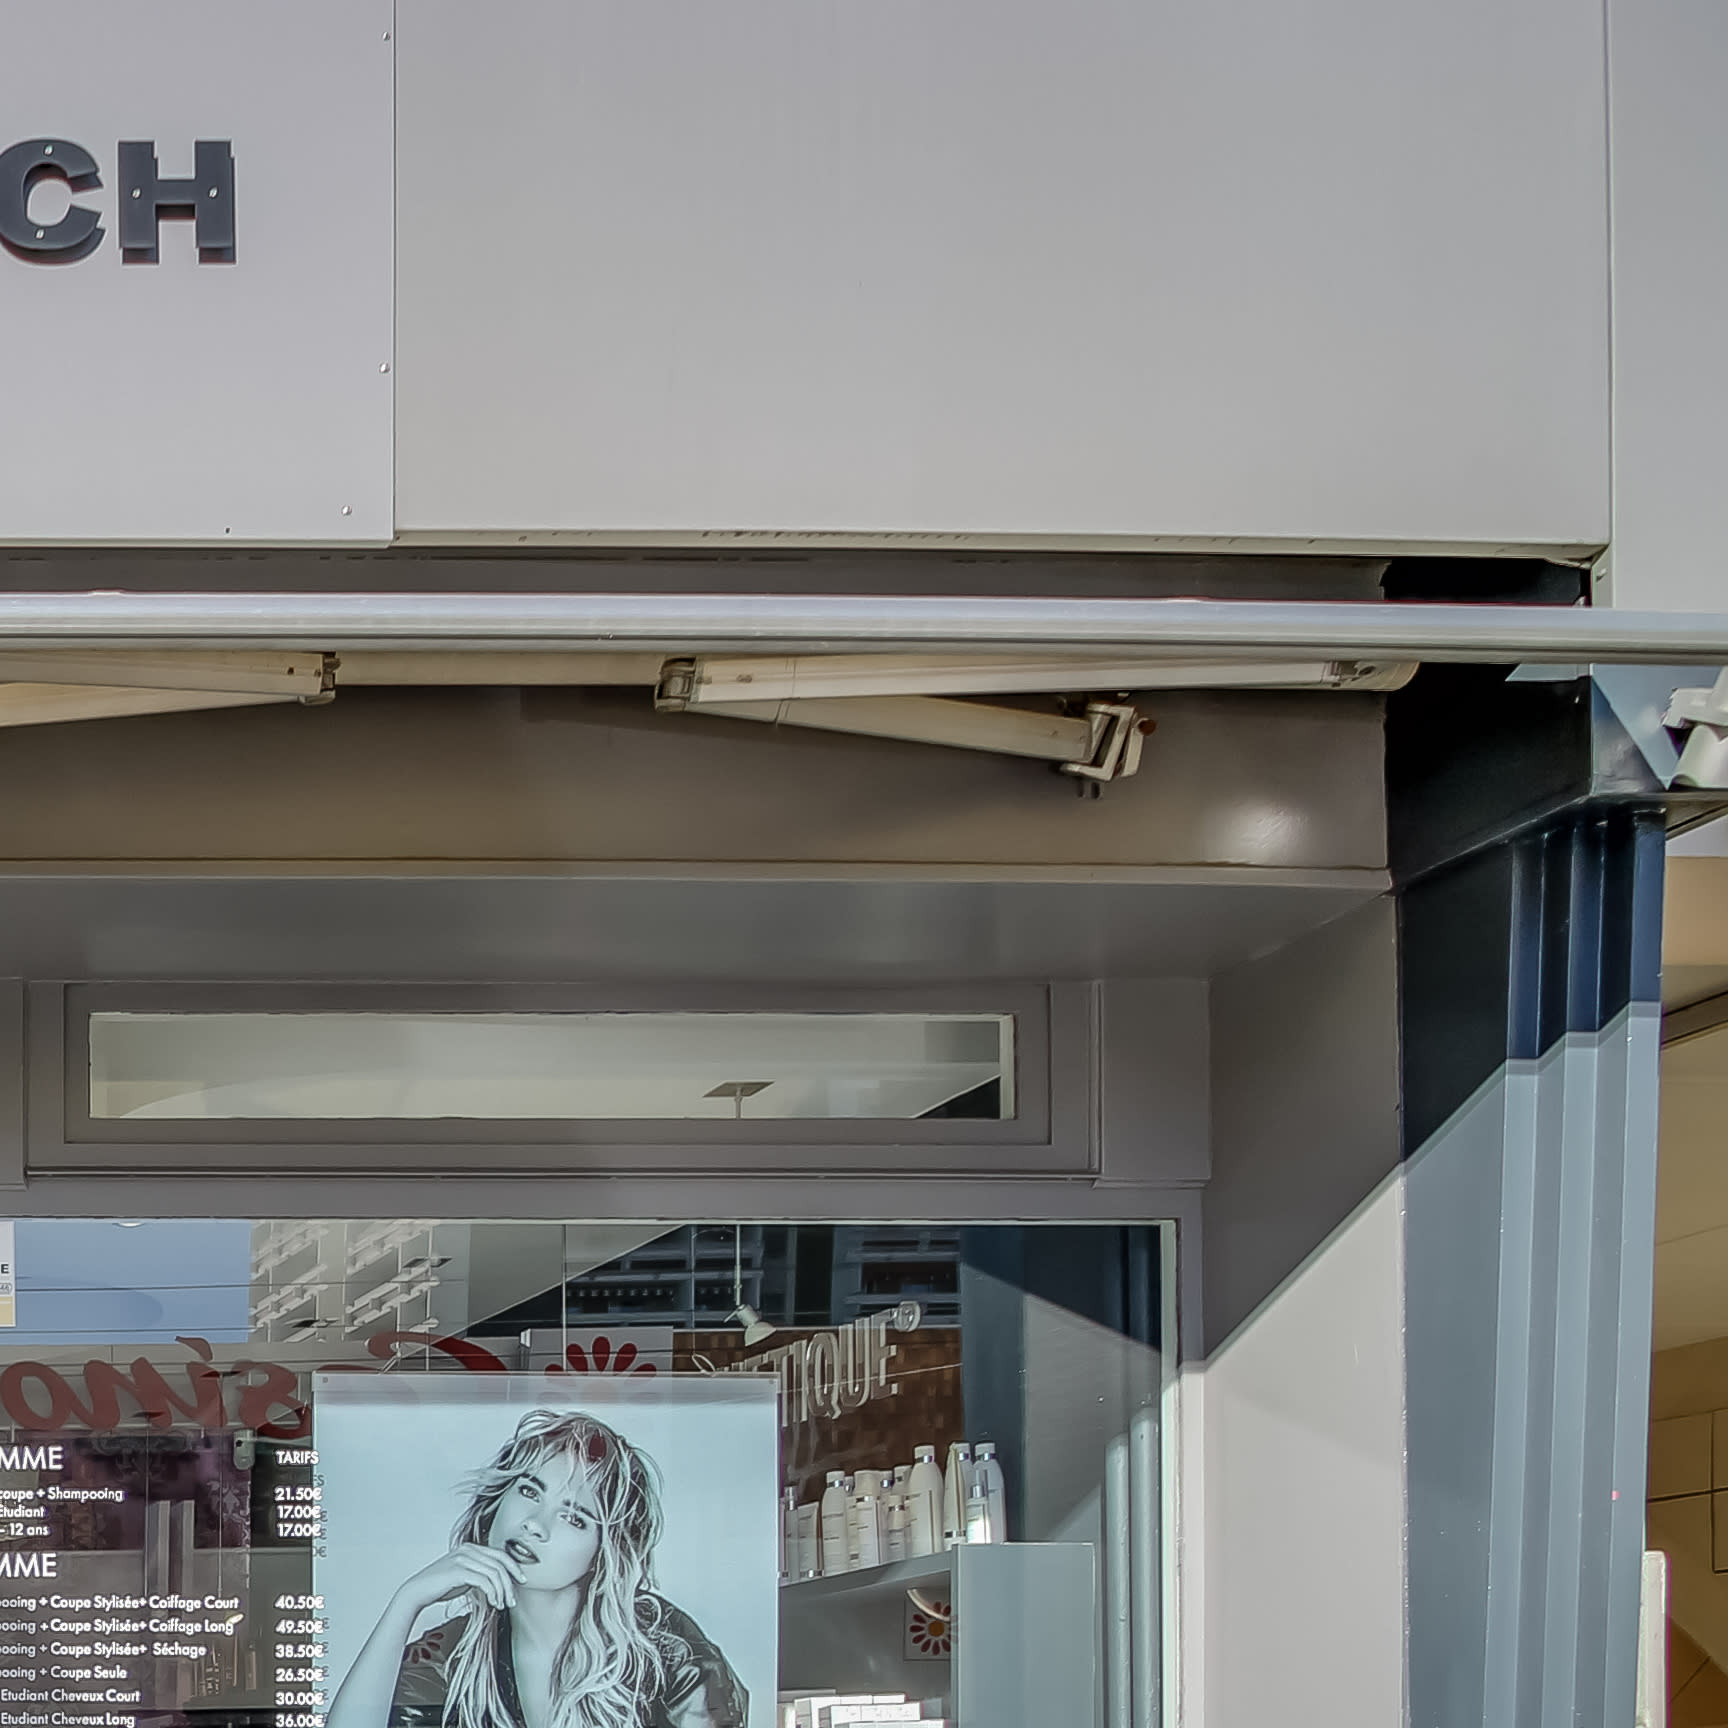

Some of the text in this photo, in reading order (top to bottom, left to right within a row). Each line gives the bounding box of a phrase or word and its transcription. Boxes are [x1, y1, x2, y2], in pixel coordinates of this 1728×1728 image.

[276, 1451, 320, 1465] TARIFS
[47, 1486, 124, 1503] Shampooing
[275, 1487, 322, 1500] 21.50€
[277, 1506, 321, 1519] 17.00€
[9, 1523, 23, 1536] 12
[26, 1526, 49, 1536] ans
[277, 1523, 321, 1536] 17.00€
[50, 1596, 91, 1612] Coupe
[149, 1596, 201, 1612] Coiffage
[204, 1597, 239, 1609] Court
[275, 1596, 324, 1609] 40.50€
[50, 1620, 91, 1635] Coupe
[149, 1619, 201, 1635] Coiffage
[204, 1619, 234, 1636] Long
[275, 1620, 324, 1634] 49.50€
[50, 1644, 91, 1658] Coupe
[152, 1642, 206, 1659] Séchage
[275, 1644, 324, 1658] 38.50€
[50, 1666, 91, 1681] Coupe
[94, 1665, 128, 1679] Seule
[275, 1668, 324, 1682] 26.50€
[1, 1689, 48, 1701] Etudiant
[51, 1689, 104, 1702] Cheveux
[106, 1690, 141, 1702] Court
[275, 1692, 324, 1706] 30.00€
[1, 1713, 48, 1725] Etudiant
[51, 1713, 104, 1725] Cheveux
[106, 1713, 135, 1728] Long
[276, 1715, 324, 1728] 36.00€
